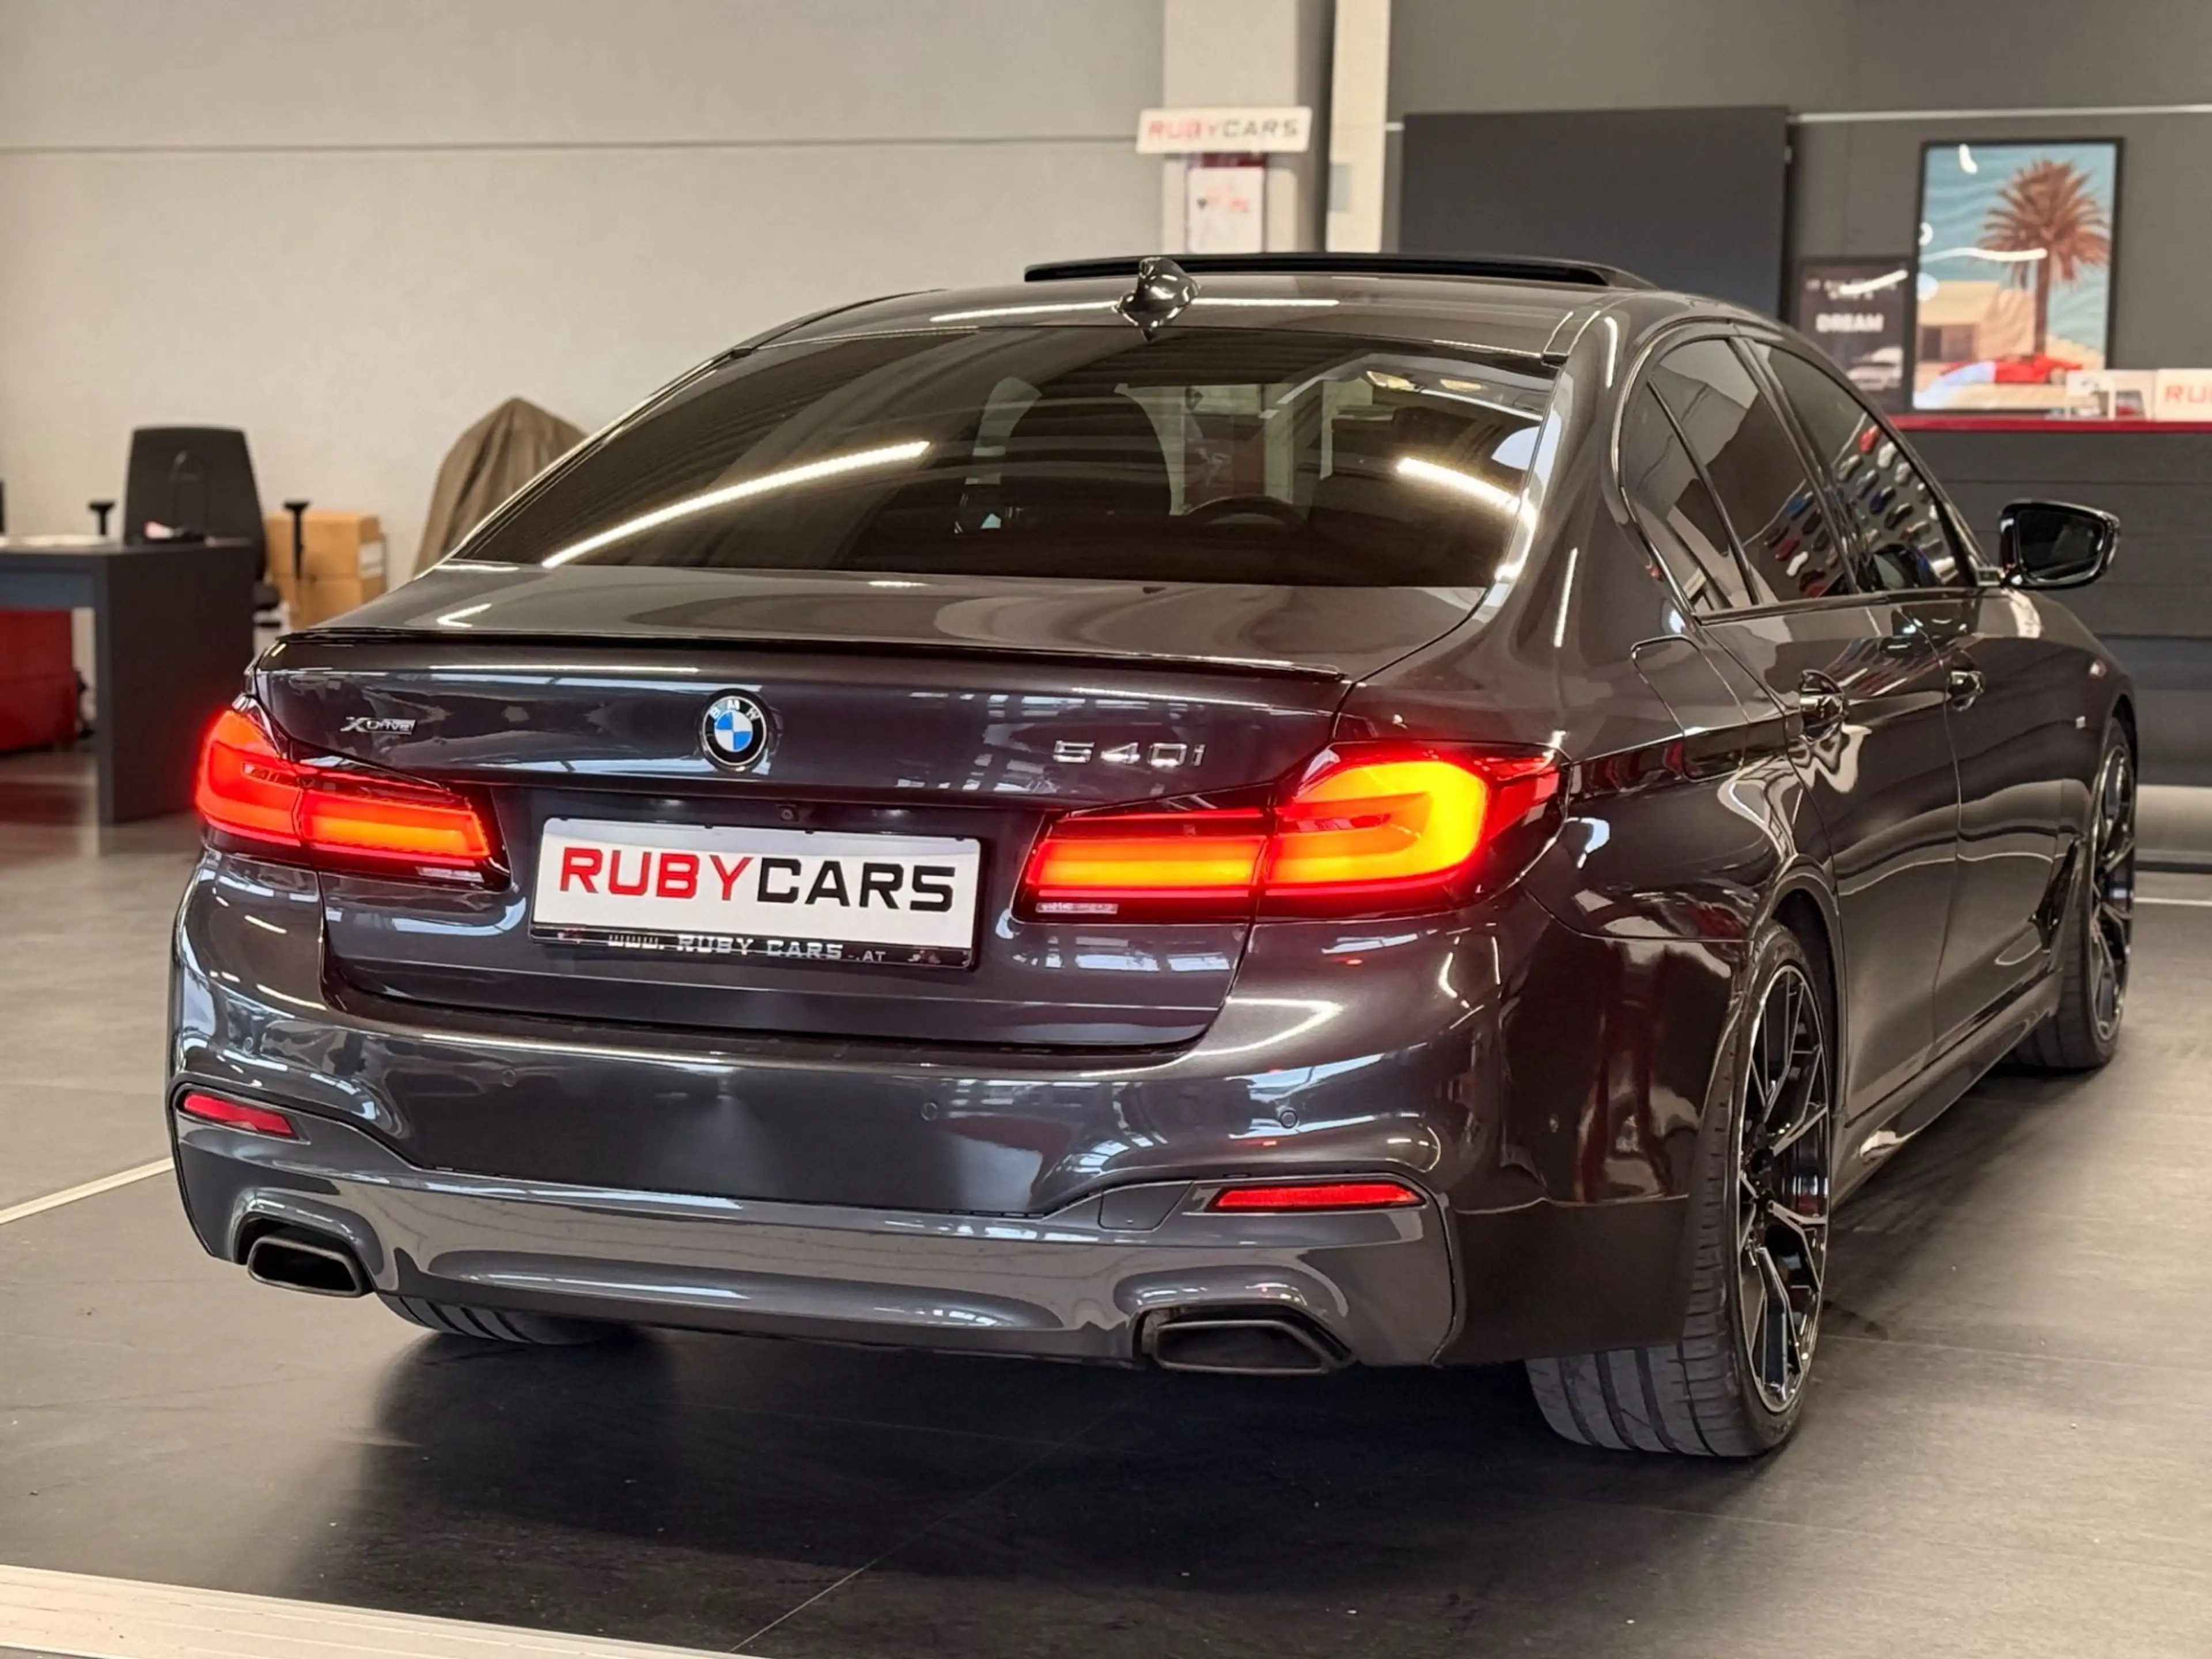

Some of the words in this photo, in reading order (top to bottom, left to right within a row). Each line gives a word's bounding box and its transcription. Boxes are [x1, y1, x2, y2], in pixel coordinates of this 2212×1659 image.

[1149, 118, 1299, 139] RUBYCARS
[1816, 313, 1885, 332] DREAM
[2166, 385, 2212, 404] RU
[709, 699, 761, 721] BMW
[1052, 740, 1205, 767] 540i
[559, 846, 956, 912] RUBYCARS
[677, 934, 754, 956] RUBY
[767, 940, 843, 960] CARS
